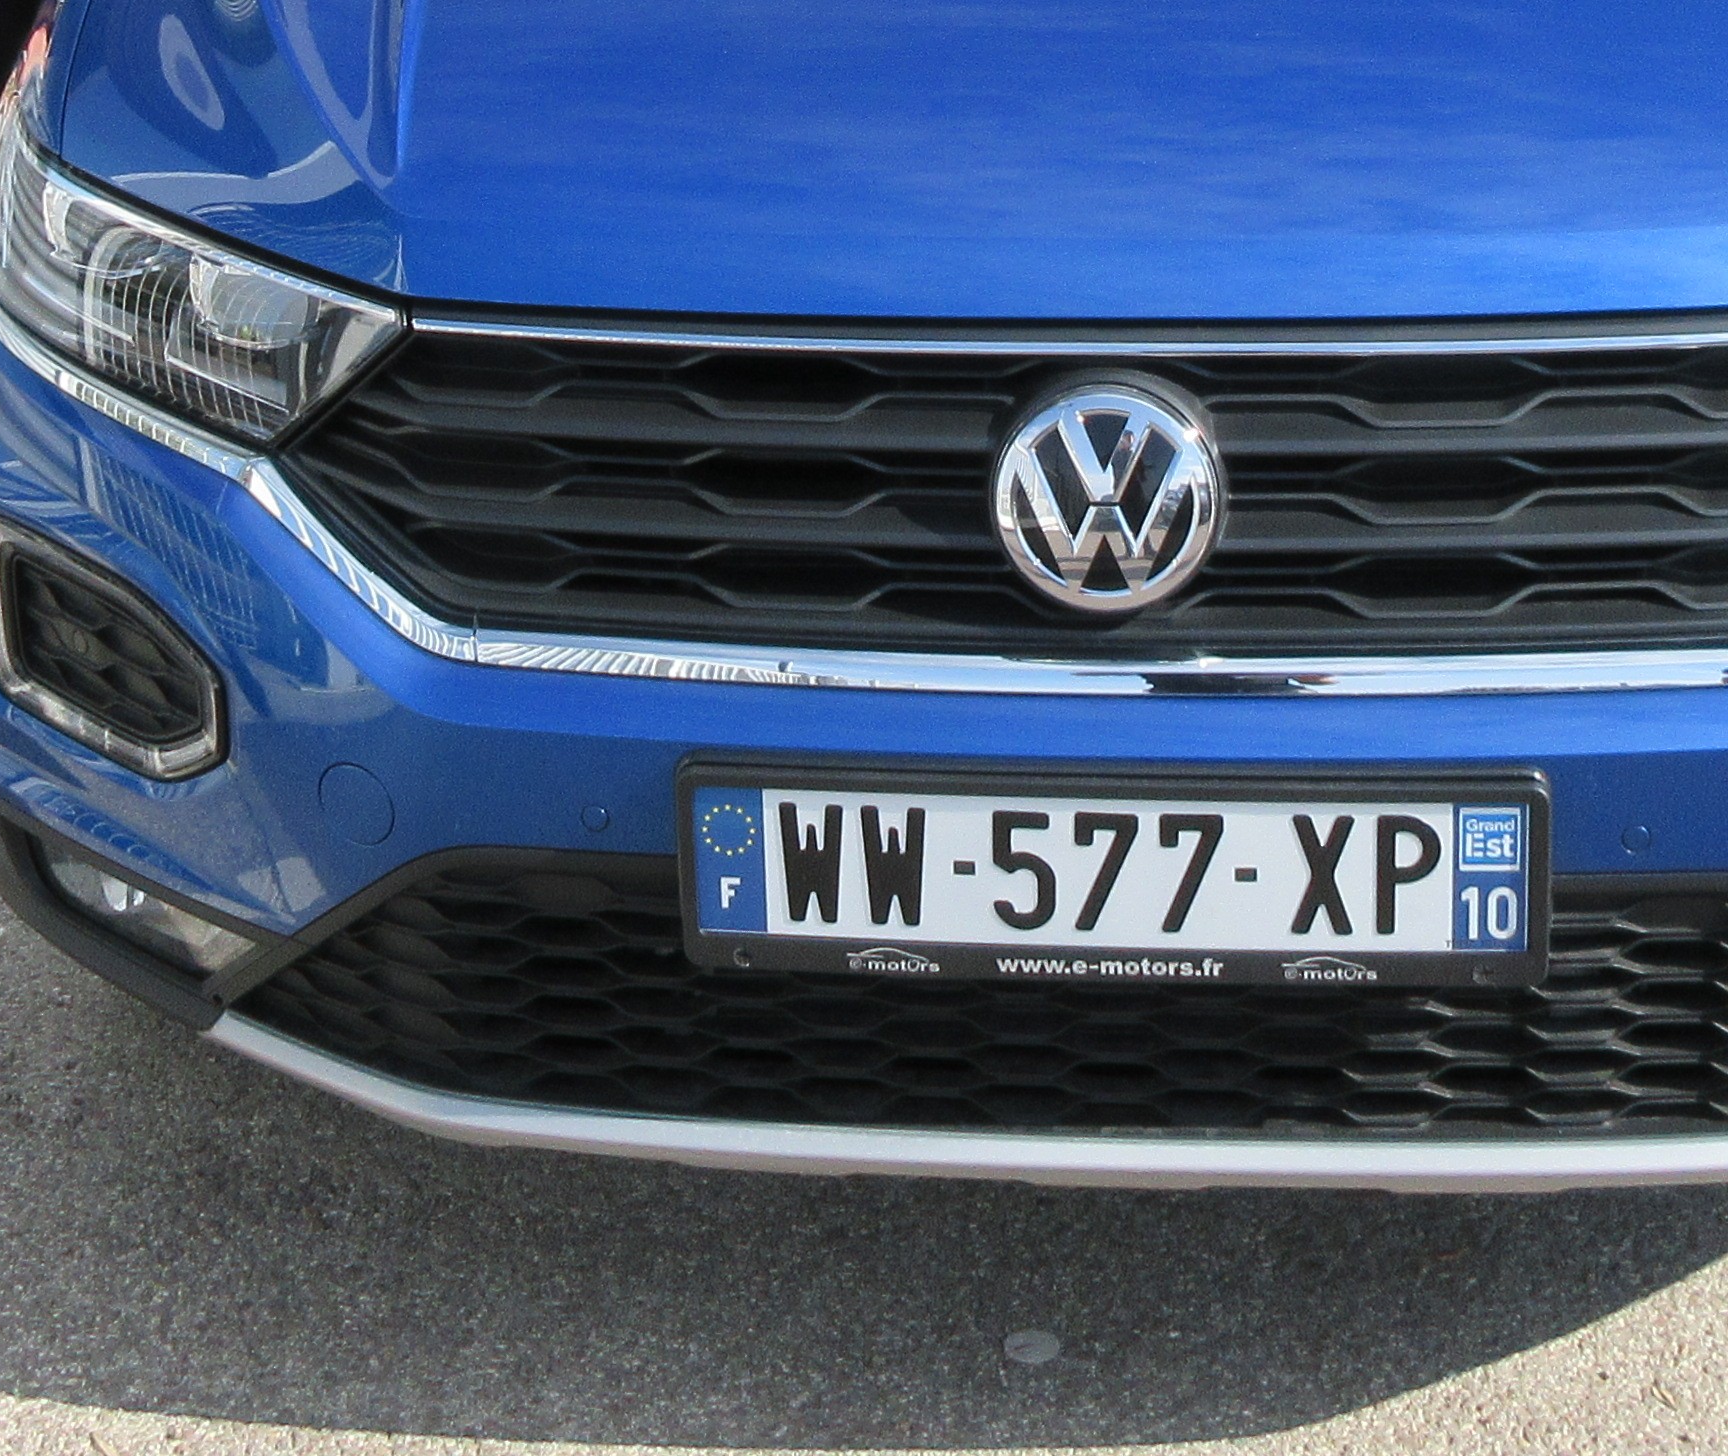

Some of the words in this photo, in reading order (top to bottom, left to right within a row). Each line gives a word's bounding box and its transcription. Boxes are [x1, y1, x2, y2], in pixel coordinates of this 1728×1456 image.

[1465, 817, 1515, 832] Grand
[1465, 834, 1515, 859] Est
[778, 801, 1442, 935] WW-577-XP
[719, 876, 741, 909] F
[1460, 886, 1518, 941] 10
[996, 957, 1224, 978] www.e-motors.fr
